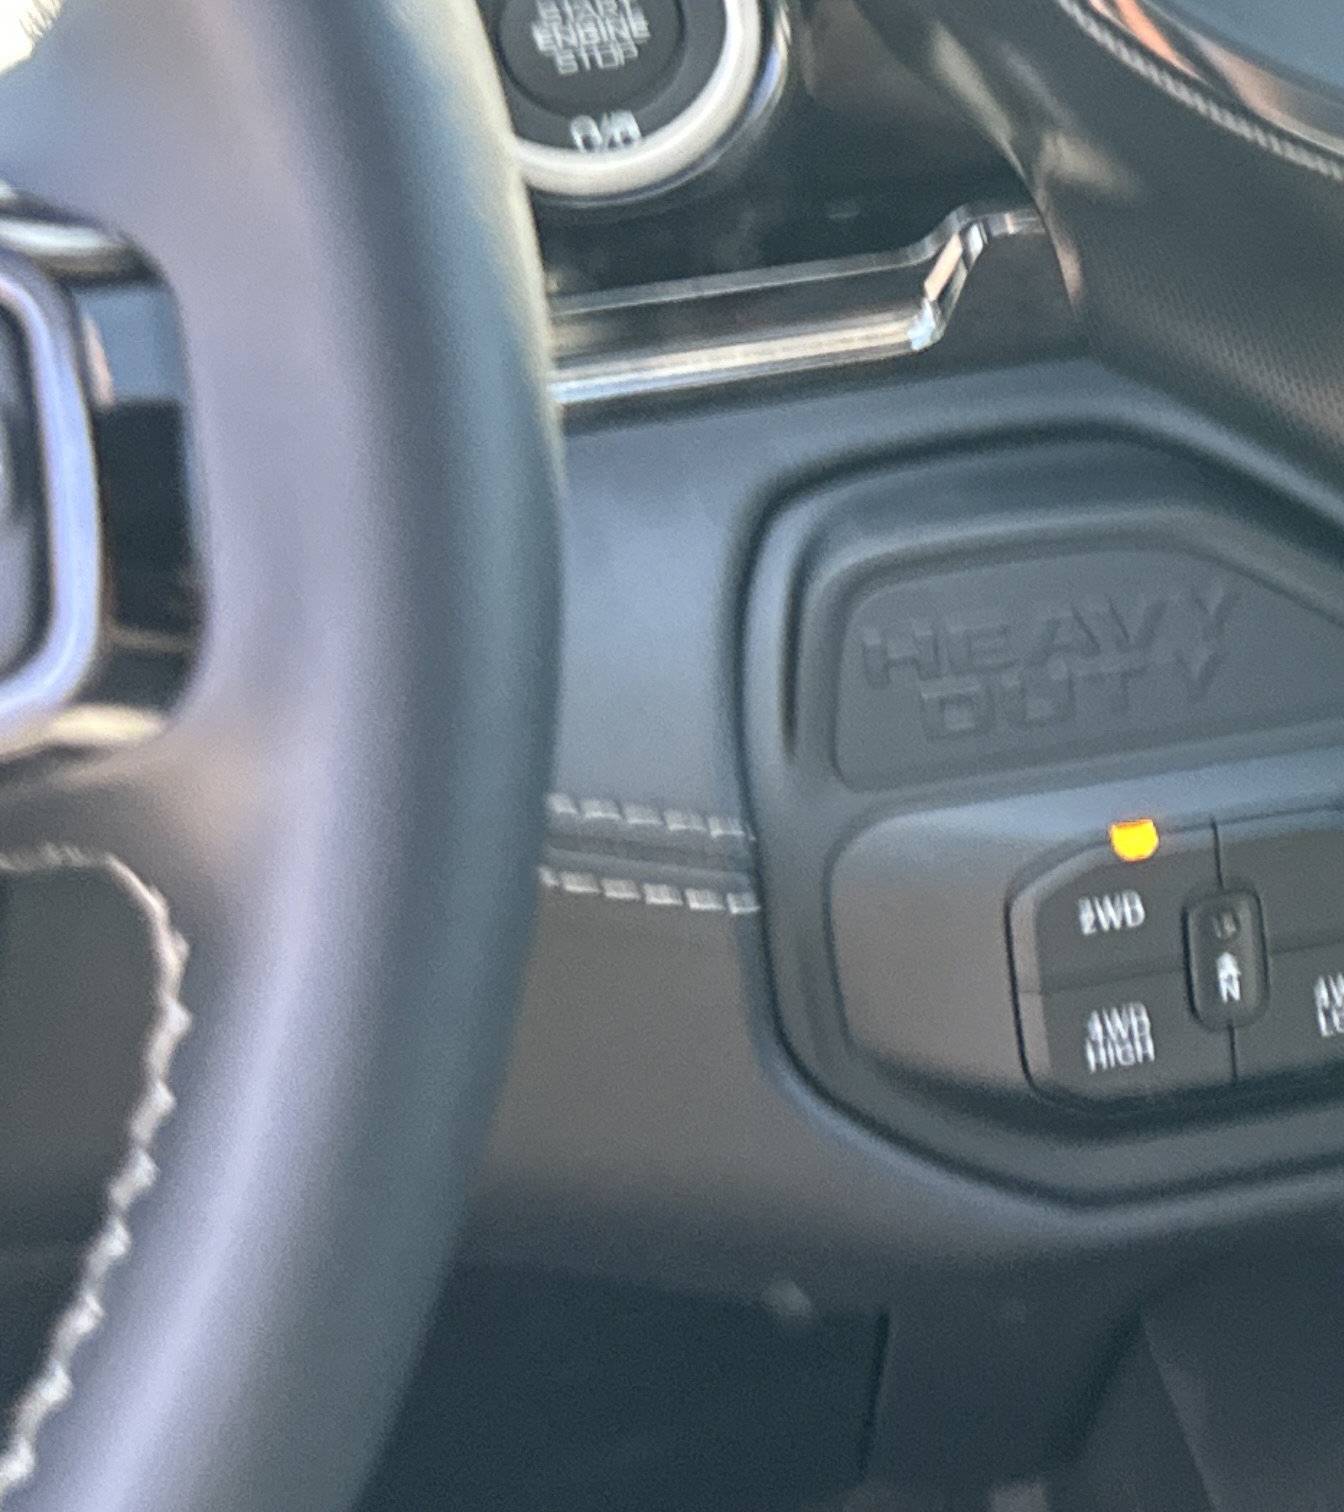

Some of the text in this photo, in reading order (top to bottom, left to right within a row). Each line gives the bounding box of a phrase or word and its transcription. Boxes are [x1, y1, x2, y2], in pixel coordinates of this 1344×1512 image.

[531, 6, 651, 55] ENGINE
[555, 38, 639, 76] STOP
[861, 576, 1241, 687] HEAVY
[920, 649, 1228, 743] DUTY
[1079, 889, 1146, 935] 2WD
[1088, 1001, 1152, 1040] 4WD
[1086, 1029, 1156, 1073] HIGH
